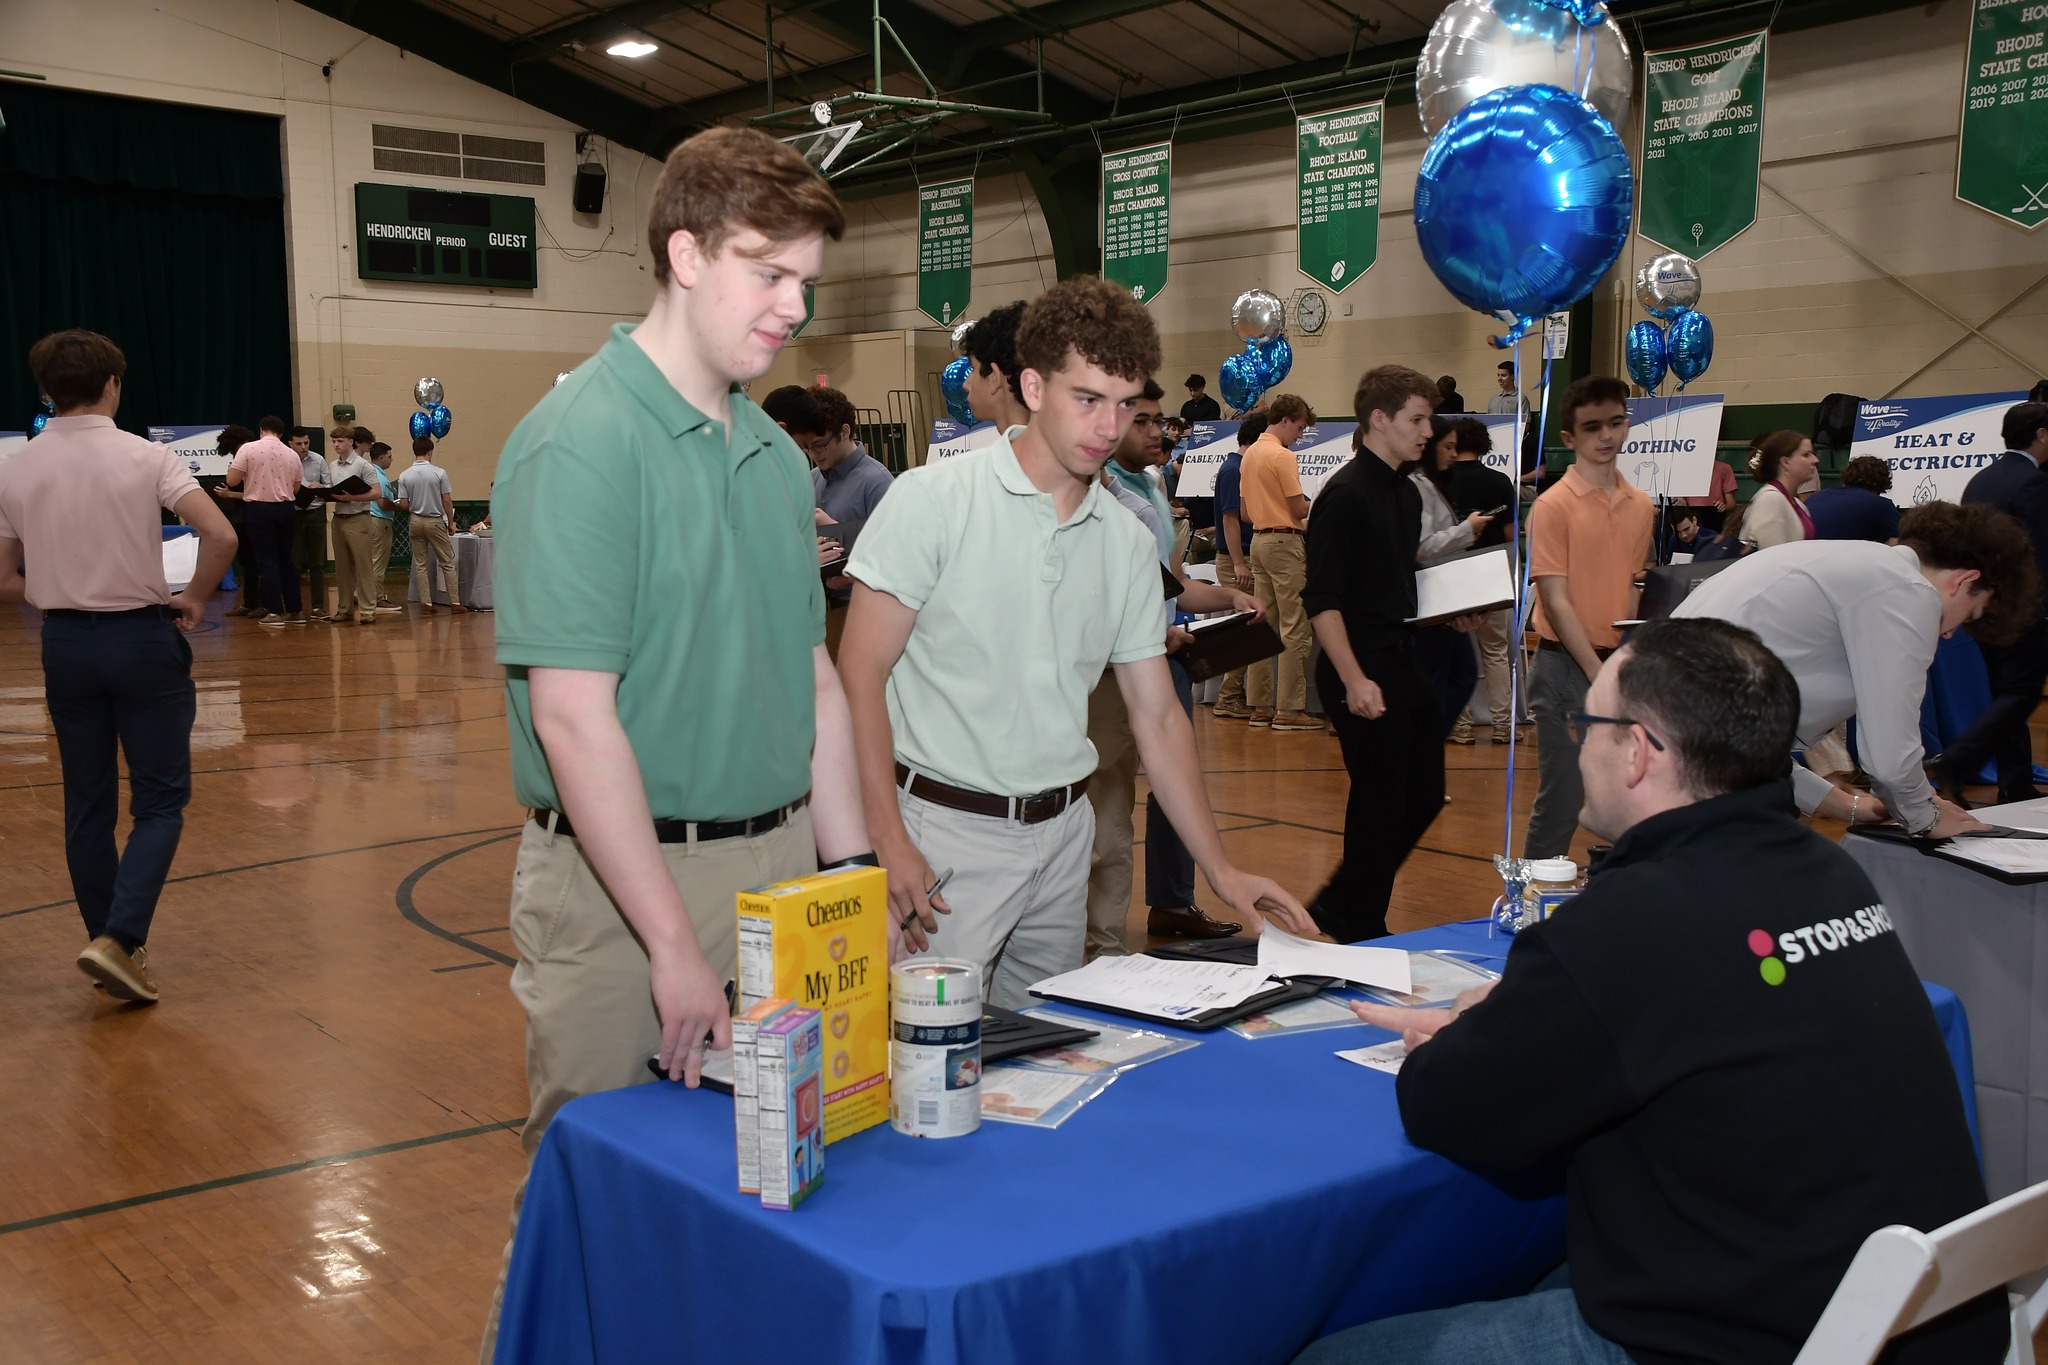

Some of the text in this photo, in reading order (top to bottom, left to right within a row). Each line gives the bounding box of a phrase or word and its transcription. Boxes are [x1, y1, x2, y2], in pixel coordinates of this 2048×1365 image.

[1996, 32, 2044, 54] RHODE
[1649, 42, 1761, 74] BISHOP HENDRICKEN
[1980, 58, 2021, 78] STATE
[1691, 71, 1720, 86] GOLF
[1970, 84, 1998, 96] 2006
[2002, 78, 2028, 92] 2007
[1662, 88, 1742, 112] RHODE ISLAND
[1970, 97, 1995, 110] 2019
[2000, 92, 2024, 105] 2021
[1300, 111, 1380, 135] BISHOP HENDRICKEN
[1654, 104, 1753, 132] STATE CHAMPIONS
[1318, 131, 1358, 147] FOOTBALL
[1649, 123, 1758, 148] 1983 1997 2000 2001 2017
[1105, 150, 1168, 170] BISHOP HENDRICKEN
[1310, 150, 1366, 168] RHODE ISLAND
[1647, 149, 1665, 159] 2021
[1112, 166, 1159, 182] CROSS COUNTRY
[1304, 163, 1374, 184] STATE CHAMPIONS
[1114, 184, 1158, 200] RHODE ISLAND
[1331, 194, 1344, 202] 2011
[1348, 191, 1362, 200] 2012
[1109, 196, 1166, 214] STATE CHAMPIONS
[1315, 205, 1328, 213] 2015
[1331, 203, 1344, 211] 2016
[1348, 200, 1362, 209] 2018
[946, 214, 964, 224] ISLAND
[1315, 214, 1328, 222] 2021
[367, 223, 431, 241] HENDRICKEN
[939, 226, 970, 236] CHAMPIONS
[436, 236, 466, 247] PERIOD
[488, 232, 528, 248] GUEST
[1658, 272, 1682, 280] Wave
[1861, 405, 1890, 414] Wave
[1617, 439, 1696, 454] LOTHING
[1894, 432, 1976, 448] HEAT &
[1185, 454, 1226, 464] CABLE/IN
[1296, 454, 1345, 464] ELLPHON
[1888, 453, 2004, 470] ECTRICITY
[1299, 466, 1333, 476] ECTR
[807, 895, 862, 927] Cheerios
[806, 970, 832, 1006] My
[838, 956, 868, 992] BFF
